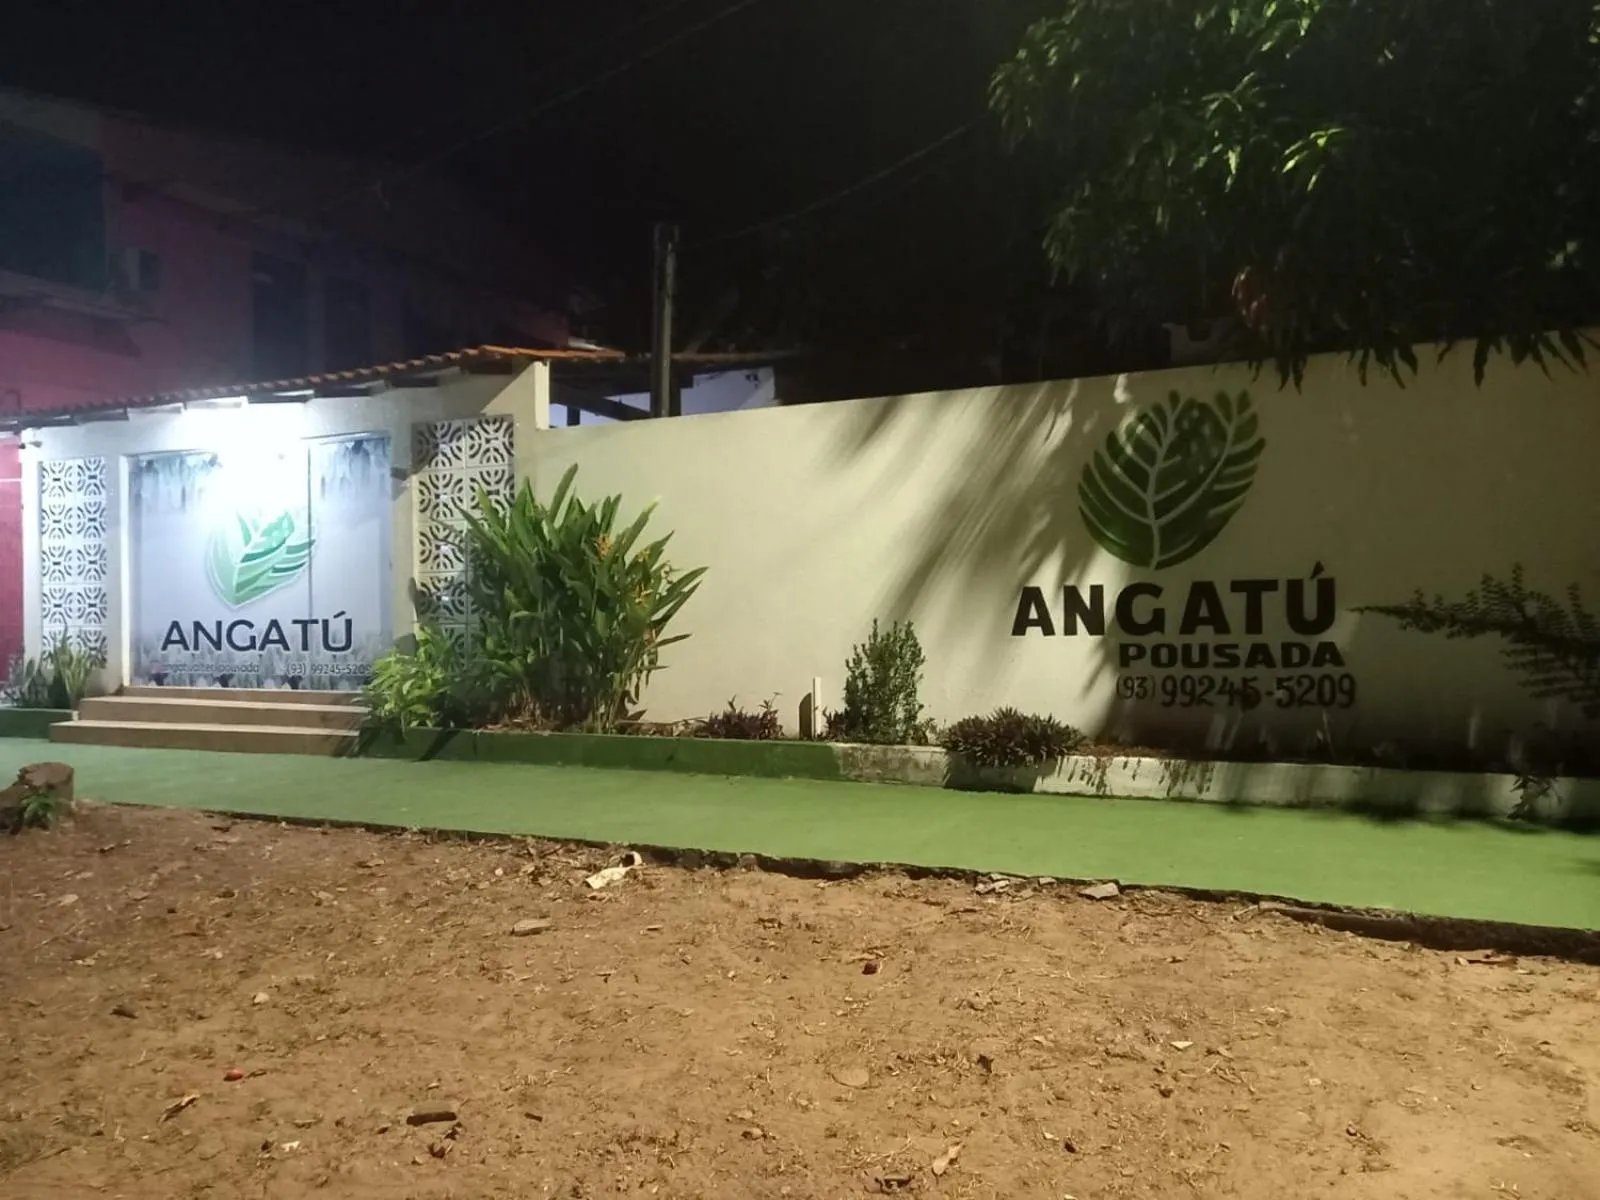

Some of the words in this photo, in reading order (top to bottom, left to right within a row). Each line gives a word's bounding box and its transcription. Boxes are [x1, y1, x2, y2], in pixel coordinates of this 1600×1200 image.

[1012, 561, 1336, 636] ANGATÚ
[161, 611, 353, 652] ANGATÚ
[286, 663, 306, 678] (93)
[1118, 641, 1346, 668] POUSADA
[1115, 675, 1157, 701] (93)
[1161, 673, 1357, 709] 99245-5209
